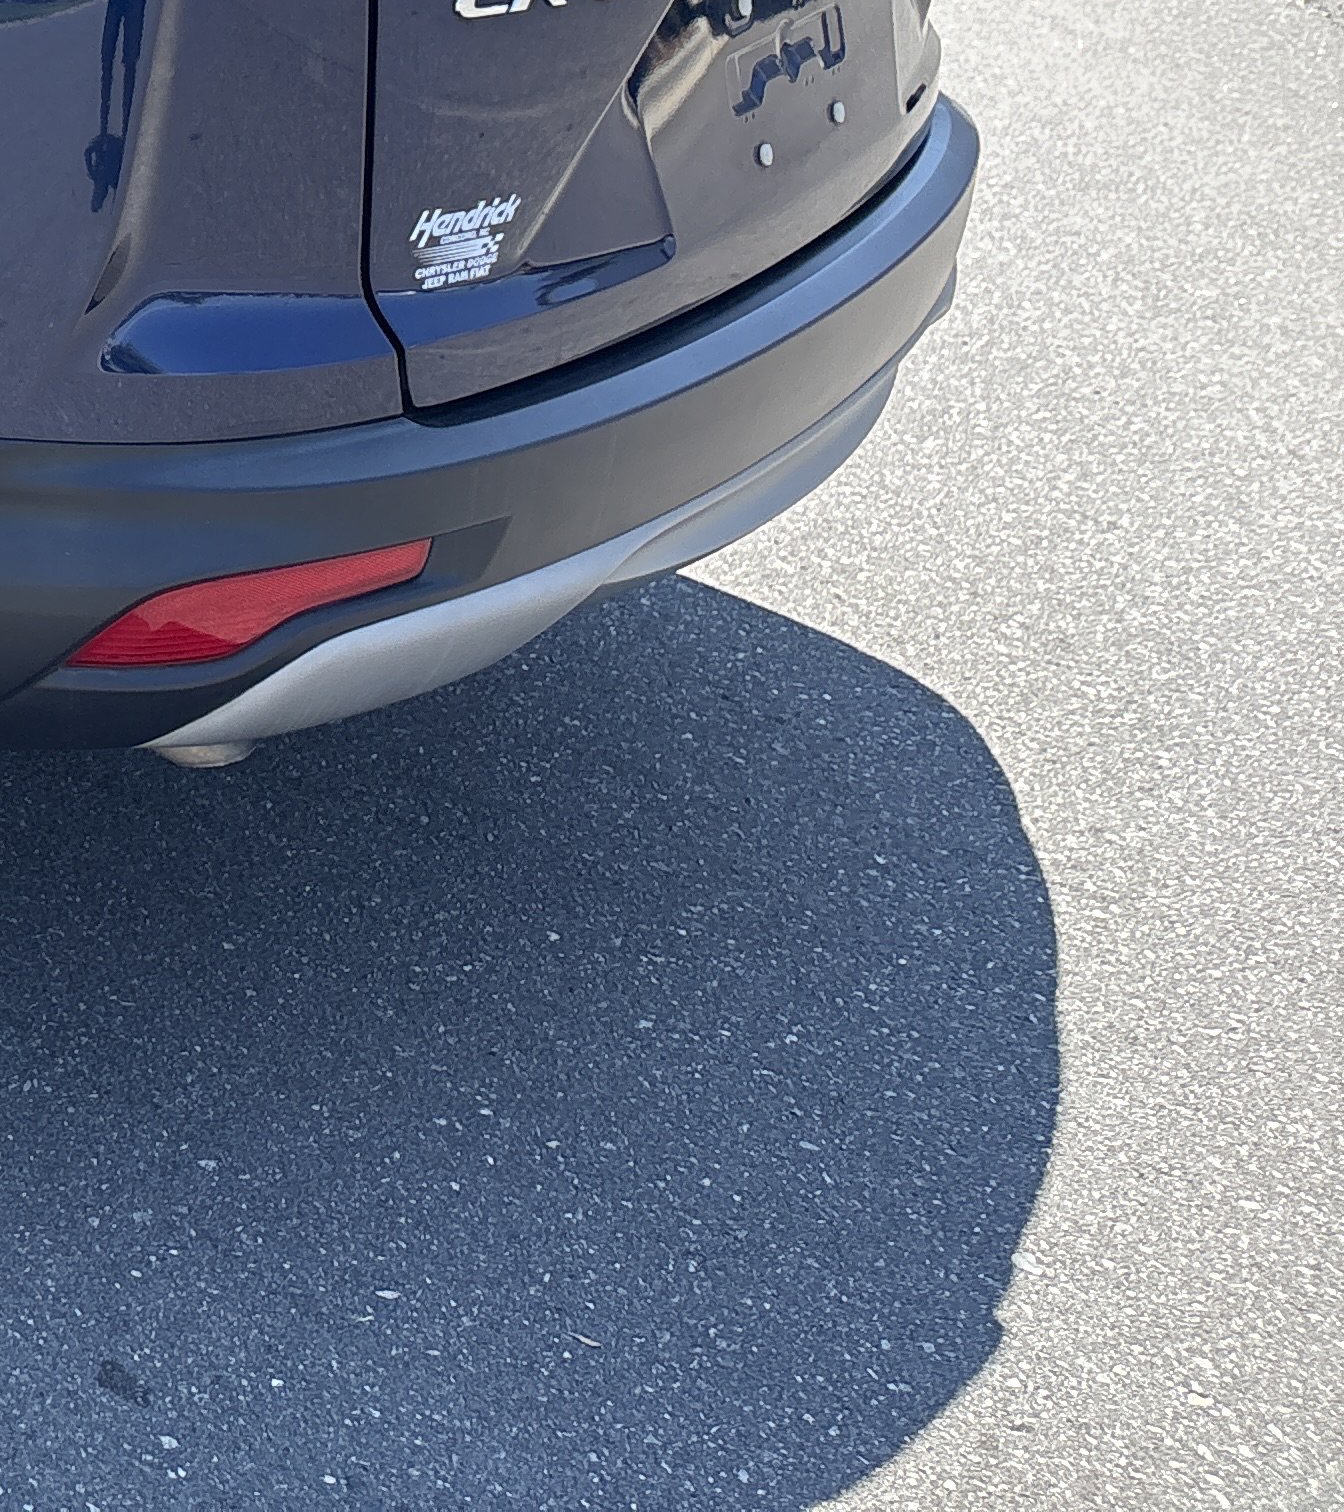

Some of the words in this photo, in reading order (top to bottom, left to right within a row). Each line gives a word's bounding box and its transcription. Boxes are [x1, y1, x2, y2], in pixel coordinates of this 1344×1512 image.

[408, 193, 522, 249] Hendrick
[414, 259, 466, 280] CHRYSLER
[466, 251, 499, 269] DODGE
[421, 275, 447, 290] JEEP
[447, 269, 469, 285] RAM
[469, 264, 492, 280] FIAT
